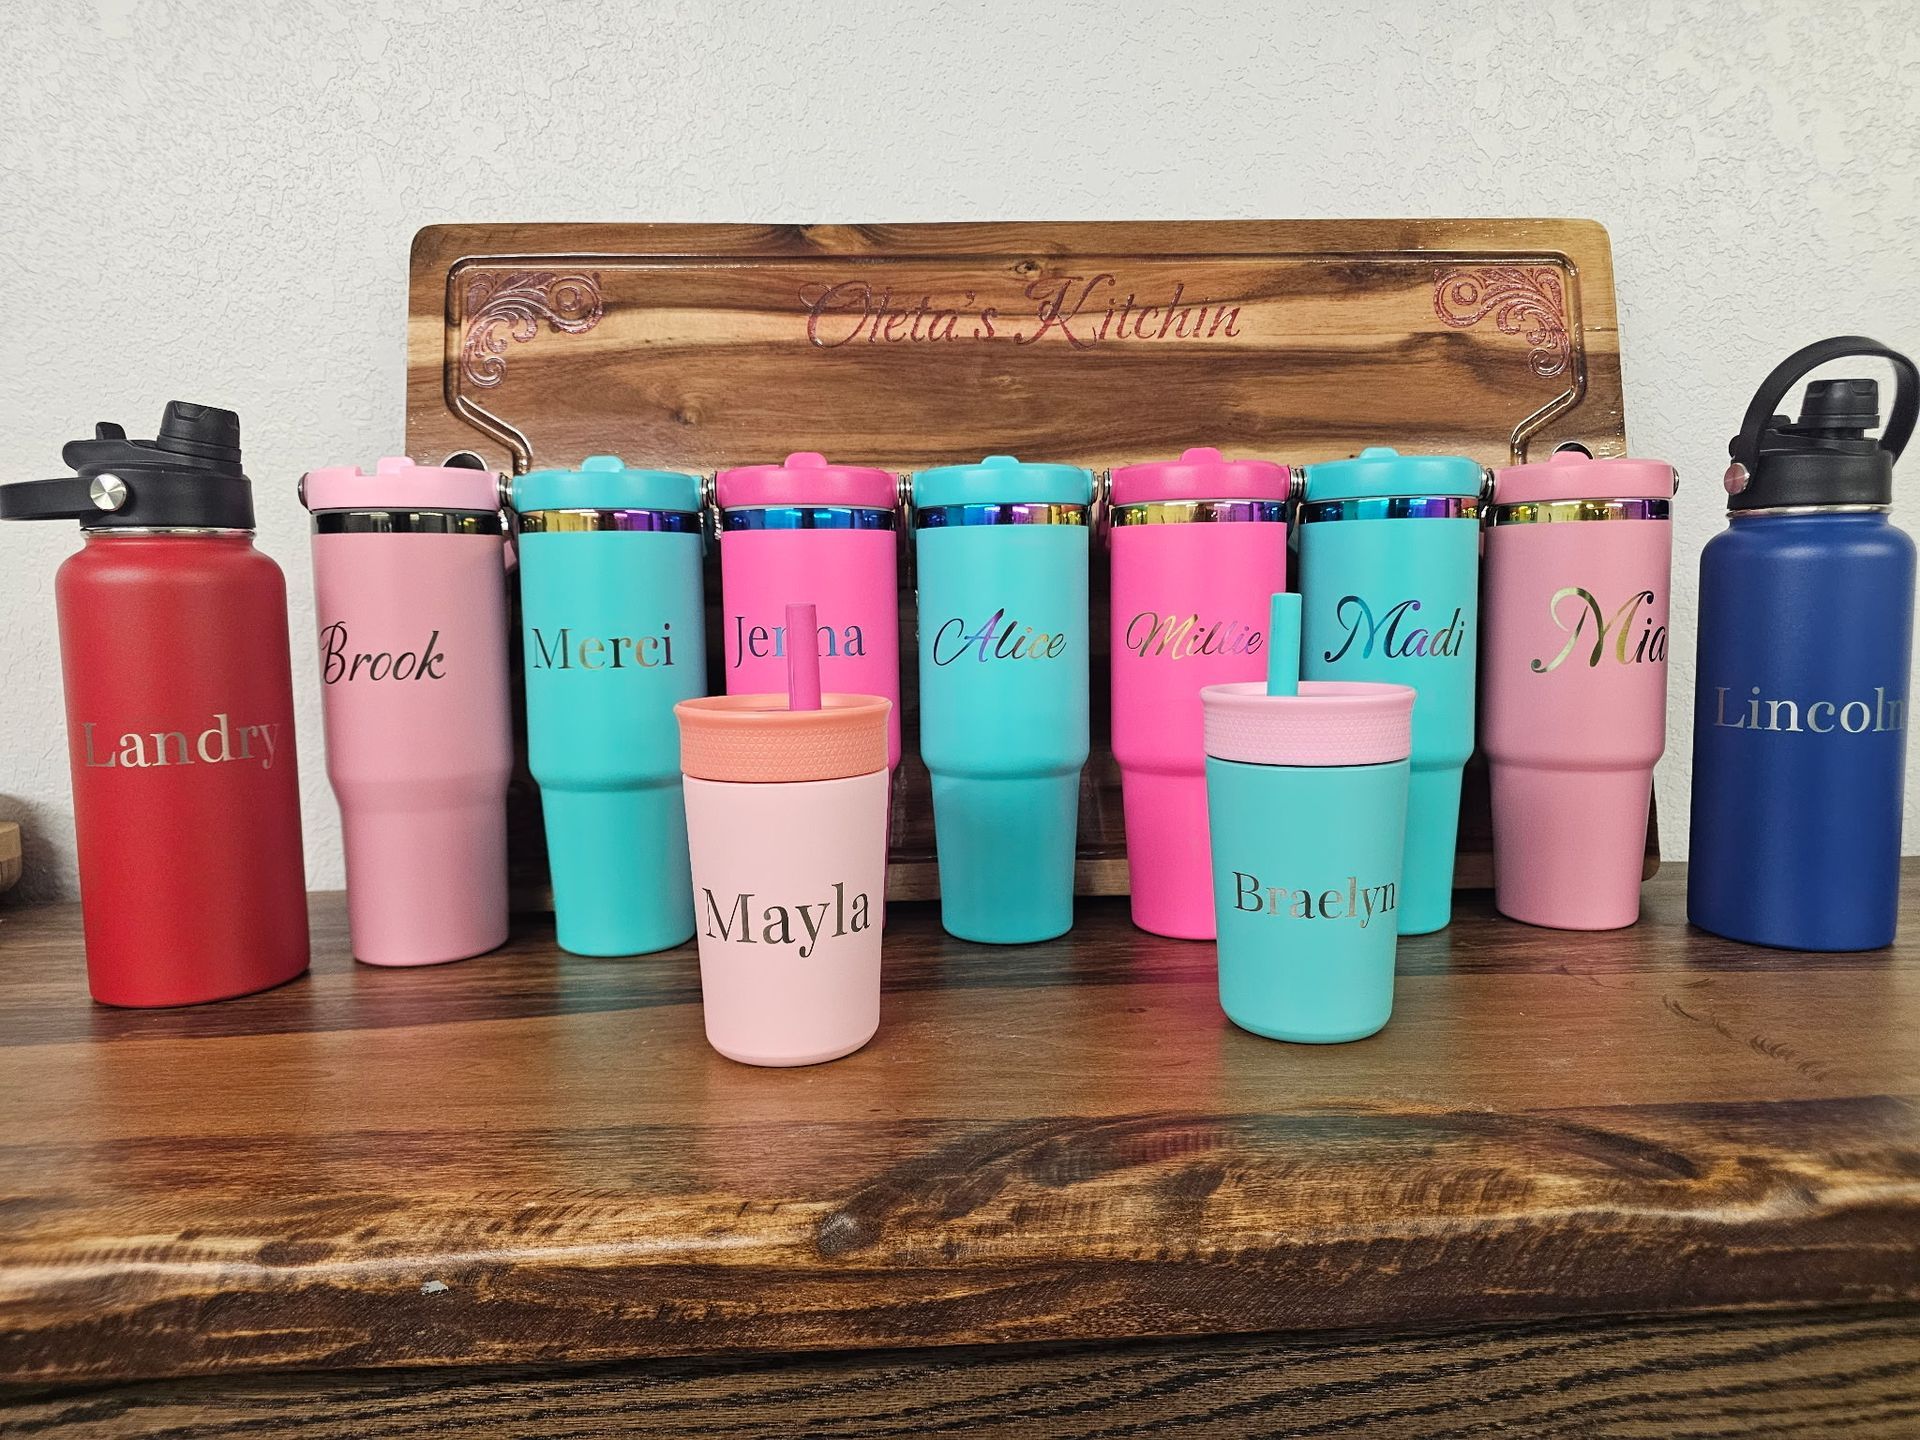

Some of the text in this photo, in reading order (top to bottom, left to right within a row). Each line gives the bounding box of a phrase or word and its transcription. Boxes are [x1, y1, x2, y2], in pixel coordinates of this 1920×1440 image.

[799, 273, 1240, 351] Oleta's Kitchin
[320, 621, 446, 685] Brook
[531, 622, 675, 669] Merci
[933, 608, 1067, 666] Alice
[1126, 612, 1264, 660] Millie
[1324, 595, 1465, 663] Madi
[1530, 586, 1666, 673] Mia
[1713, 686, 1905, 733] Lincoln
[81, 713, 280, 770] Landry
[702, 882, 871, 958] Mayla
[1232, 871, 1396, 928] Braelyn
